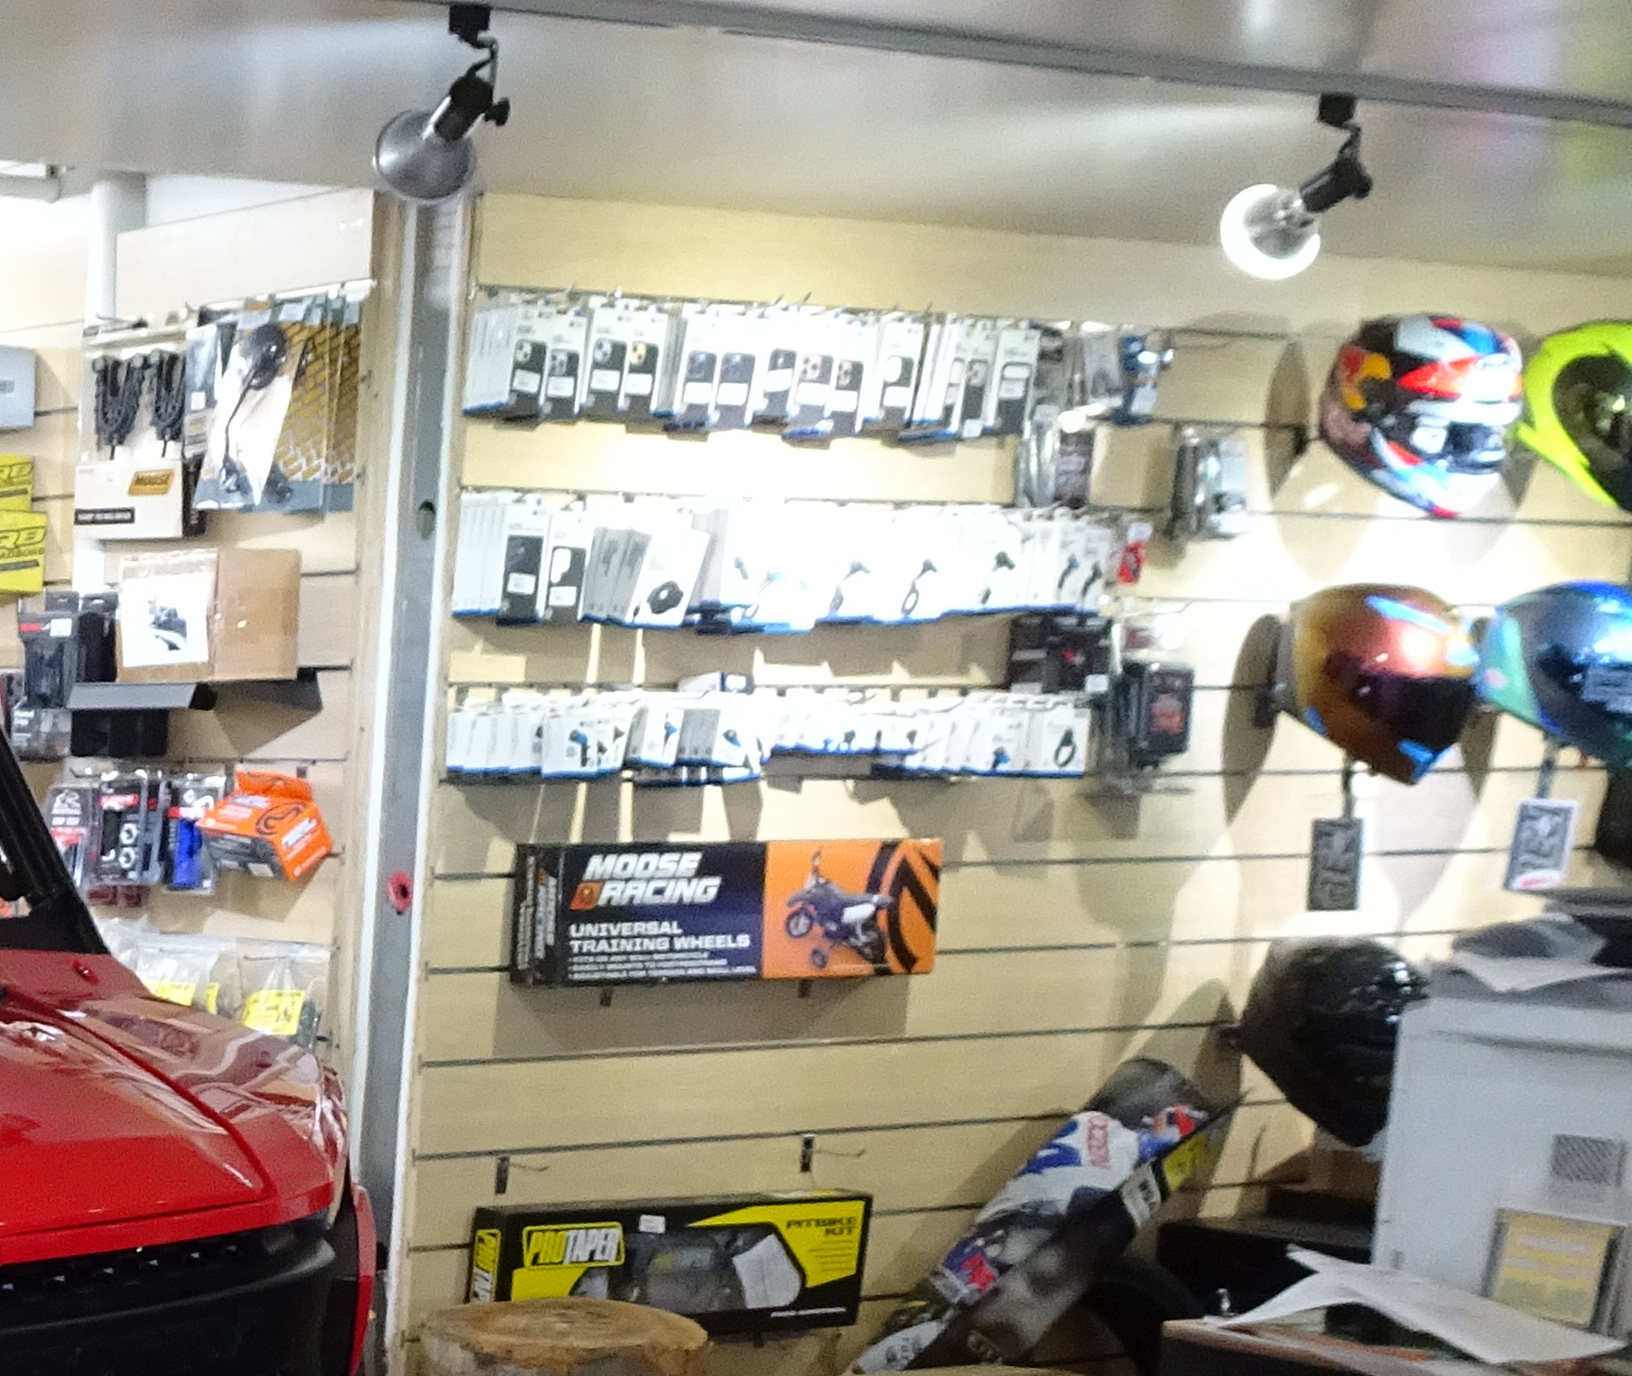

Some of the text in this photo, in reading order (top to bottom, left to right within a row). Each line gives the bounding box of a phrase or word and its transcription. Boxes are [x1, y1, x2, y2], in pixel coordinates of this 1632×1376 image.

[584, 851, 704, 880] MOOSE
[597, 876, 722, 906] RACING
[569, 921, 683, 938] UNIVERSAL
[569, 934, 751, 954] TRAINING WHEELS
[527, 1228, 620, 1266] PROTAPER
